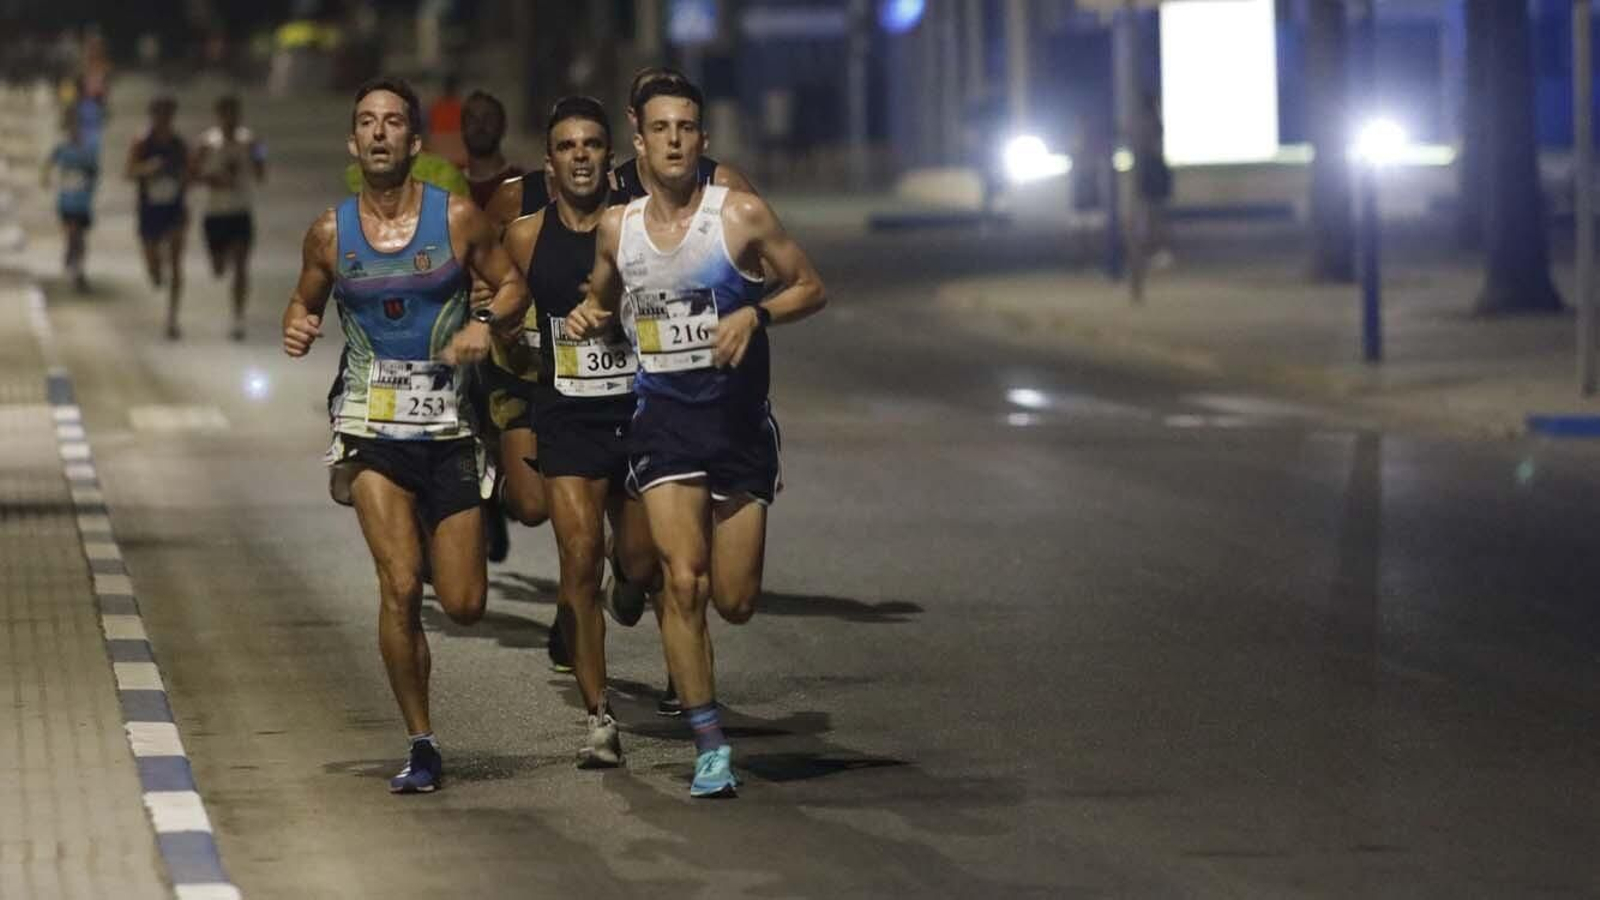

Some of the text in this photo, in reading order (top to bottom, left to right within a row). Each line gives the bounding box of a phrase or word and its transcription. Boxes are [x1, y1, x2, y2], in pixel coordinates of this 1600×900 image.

[670, 322, 709, 345] 216
[586, 350, 627, 371] 303
[408, 396, 445, 416] 253
